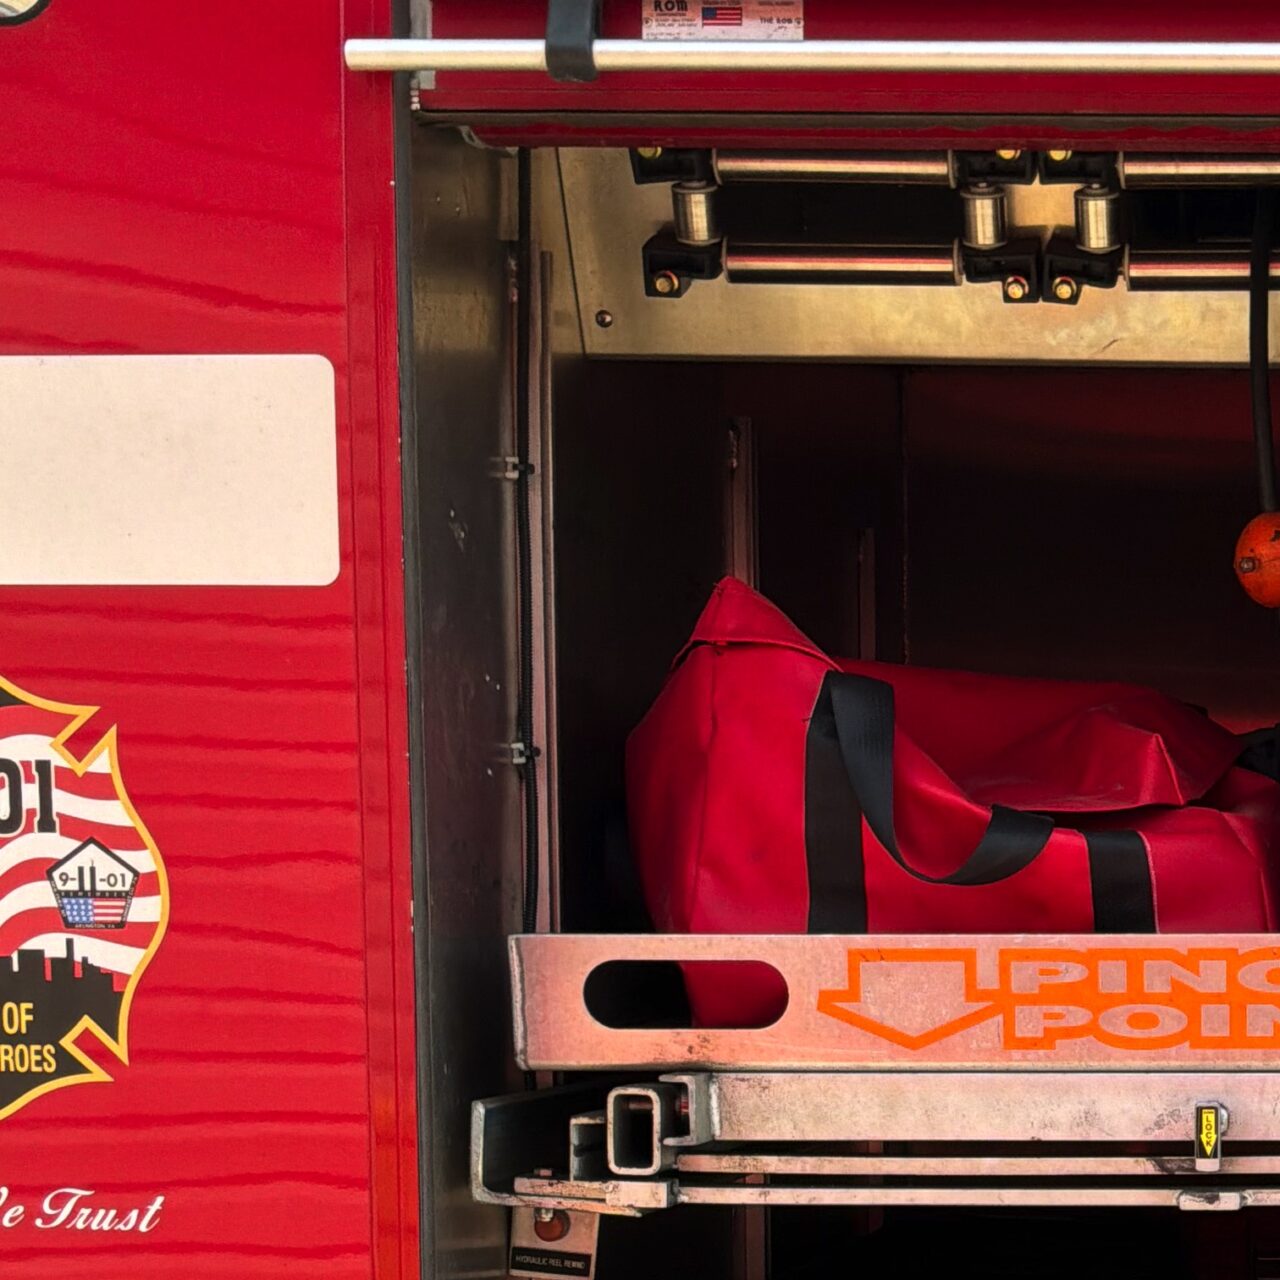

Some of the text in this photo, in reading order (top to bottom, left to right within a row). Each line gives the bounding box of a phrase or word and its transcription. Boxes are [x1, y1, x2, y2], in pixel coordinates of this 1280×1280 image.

[2, 1001, 34, 1035] OF
[1204, 1115, 1213, 1147] LOCK
[0, 1186, 165, 1233] e Trust
